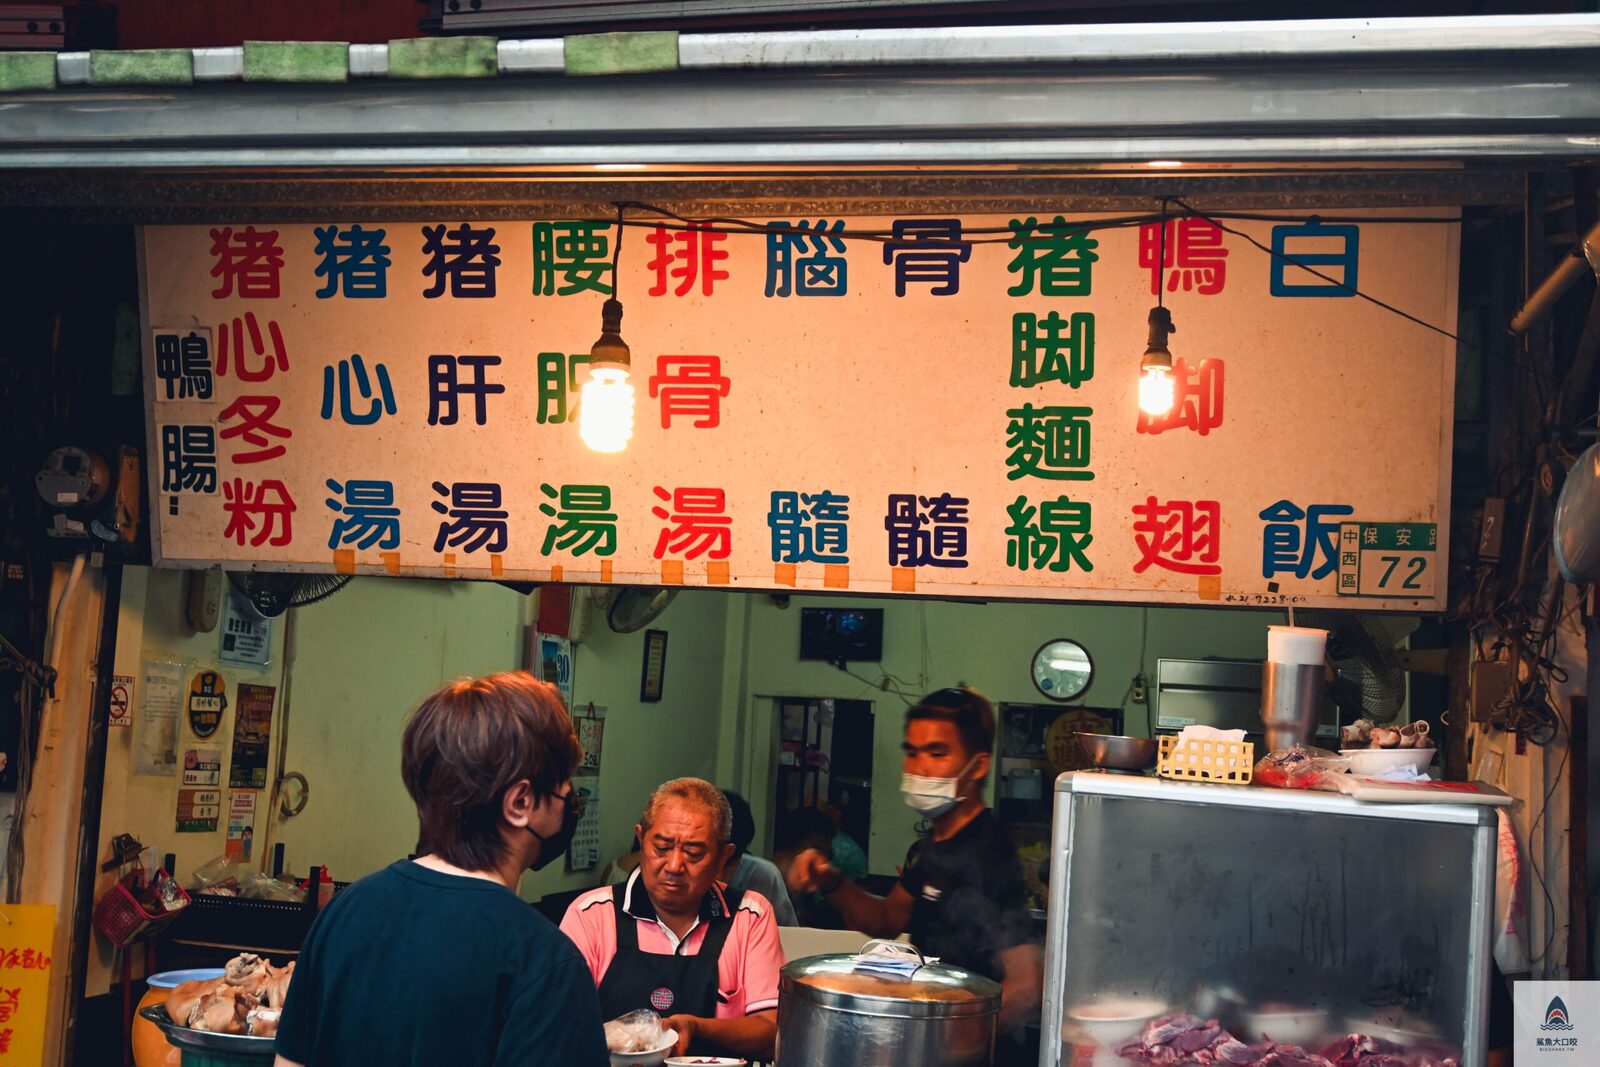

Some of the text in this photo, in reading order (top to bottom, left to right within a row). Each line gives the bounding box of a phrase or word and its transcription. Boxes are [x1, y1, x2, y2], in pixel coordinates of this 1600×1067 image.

[155, 331, 217, 493] 鴨腸
[645, 222, 733, 561] 排骨湯
[882, 218, 972, 568] 骨髓
[1257, 215, 1360, 580] 白飯
[1341, 529, 1358, 588] 中西區
[1377, 556, 1428, 589] 72
